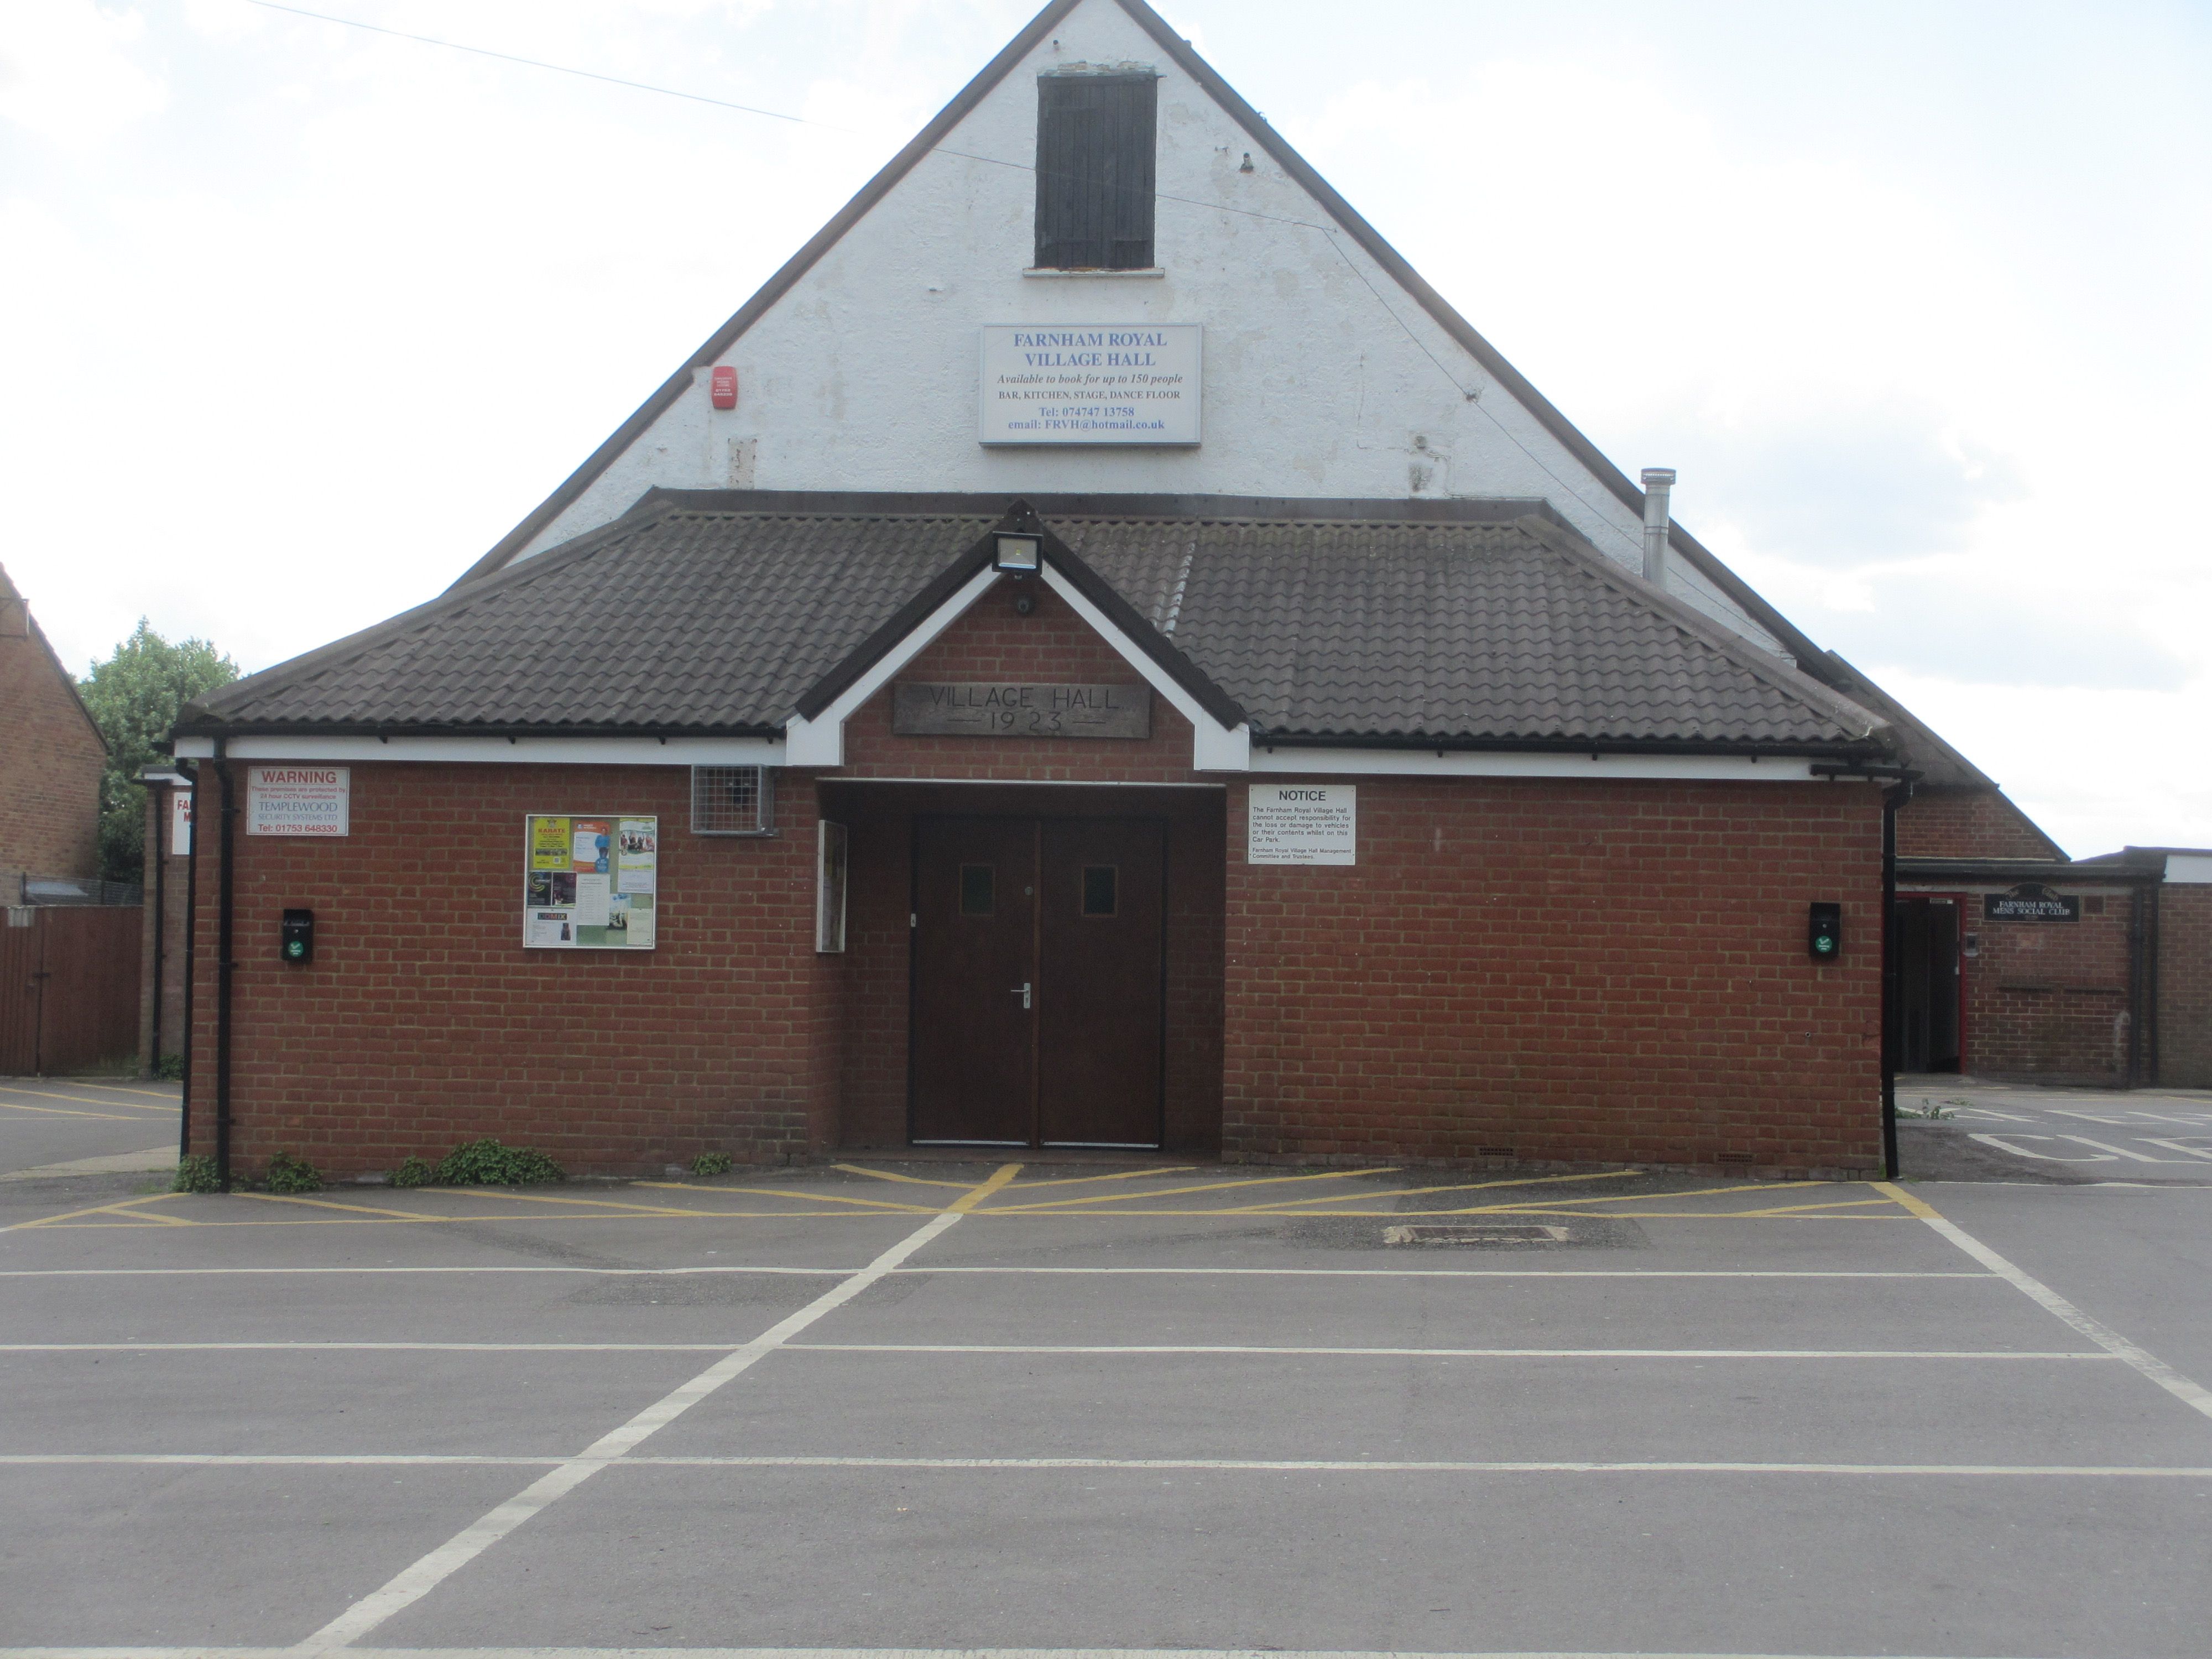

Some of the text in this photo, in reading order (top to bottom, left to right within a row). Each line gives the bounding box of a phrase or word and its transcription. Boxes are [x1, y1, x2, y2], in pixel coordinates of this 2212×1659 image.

[1014, 332, 1167, 347] FARNHAM ROYAL
[1025, 353, 1156, 366] VILLAGE HALL
[997, 374, 1182, 385] Available to book for up to 150 people
[999, 391, 1180, 400] BAR, KITCHEN, STAGE, DANCE FLOOR
[1039, 408, 1134, 416] Tel: 074747 13758
[1008, 420, 1165, 431] email: FRVH@hotmail.co.uk
[931, 687, 1034, 707] VILLAGE
[991, 712, 1061, 731] 1923
[262, 771, 336, 783] WARNING
[1279, 790, 1326, 801] NOTICE
[178, 800, 191, 810] FA
[259, 802, 337, 811] TEMPLEWOOD
